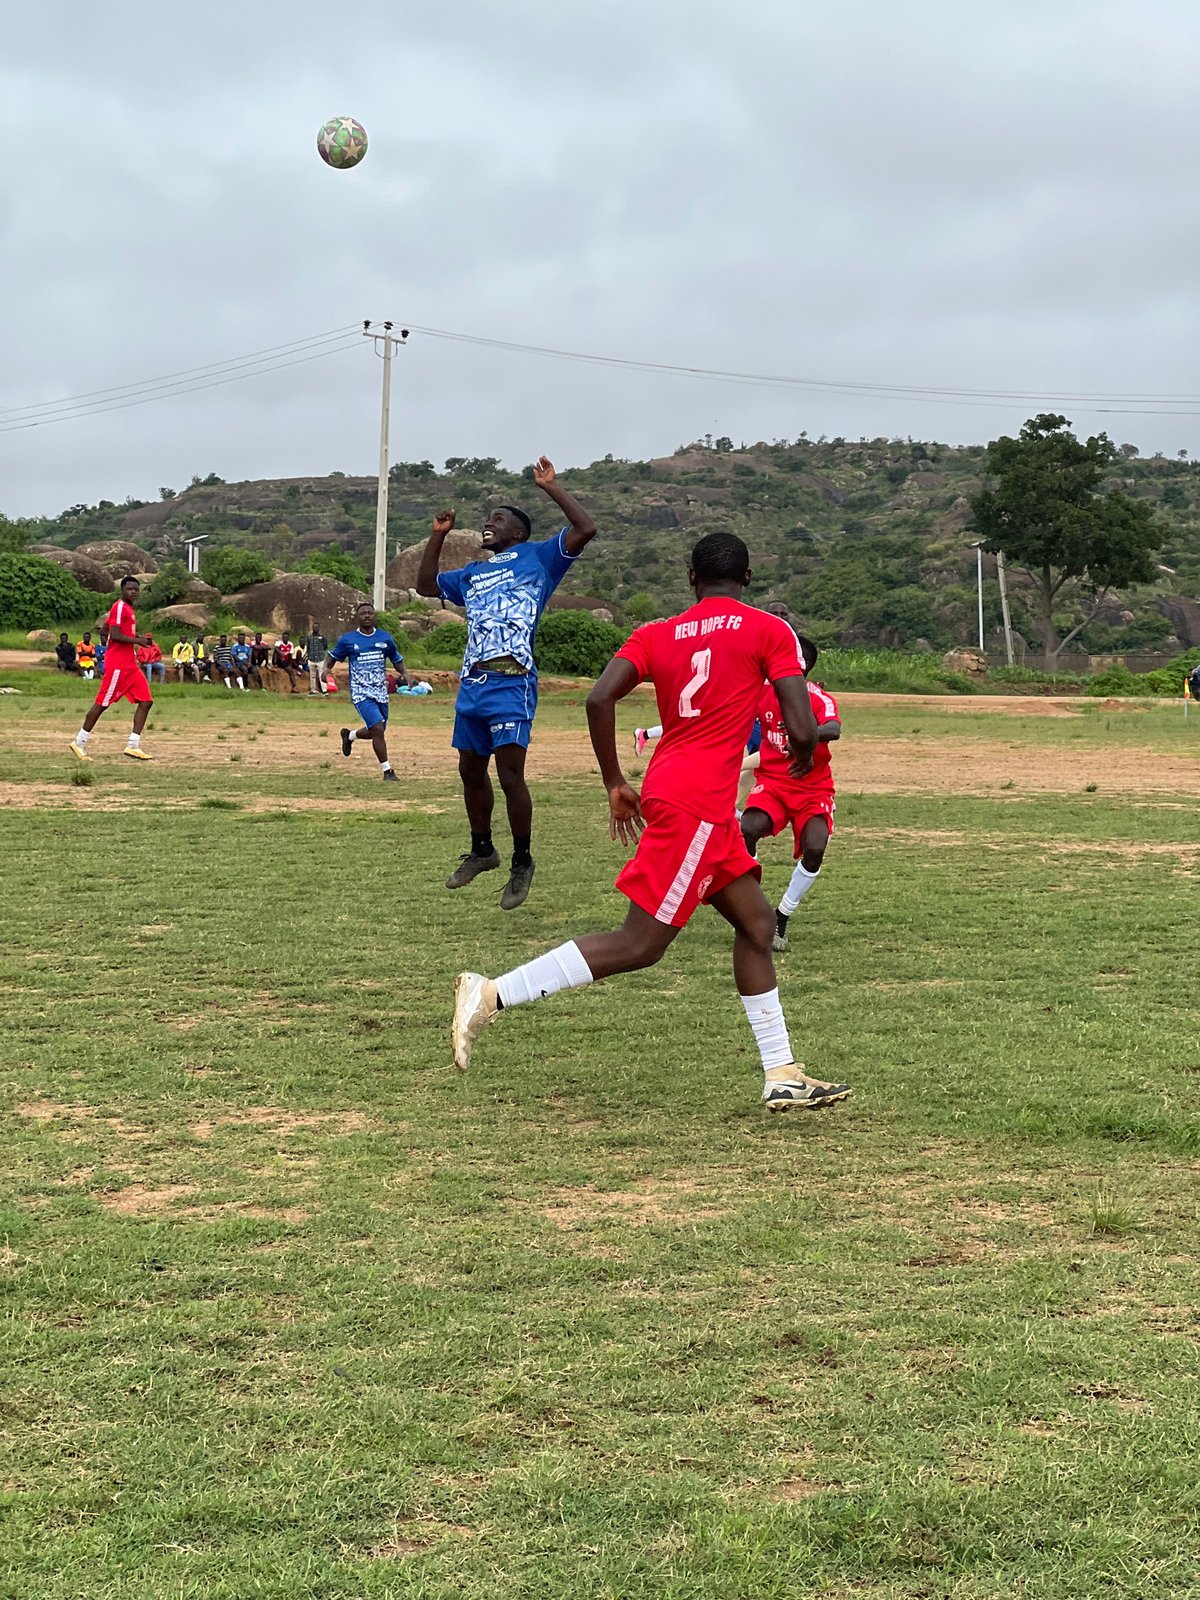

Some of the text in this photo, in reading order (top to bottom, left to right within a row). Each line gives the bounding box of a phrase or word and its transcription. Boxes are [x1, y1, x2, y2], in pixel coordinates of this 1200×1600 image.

[675, 615, 743, 641] NEW HOPE FC
[679, 647, 712, 717] 2
